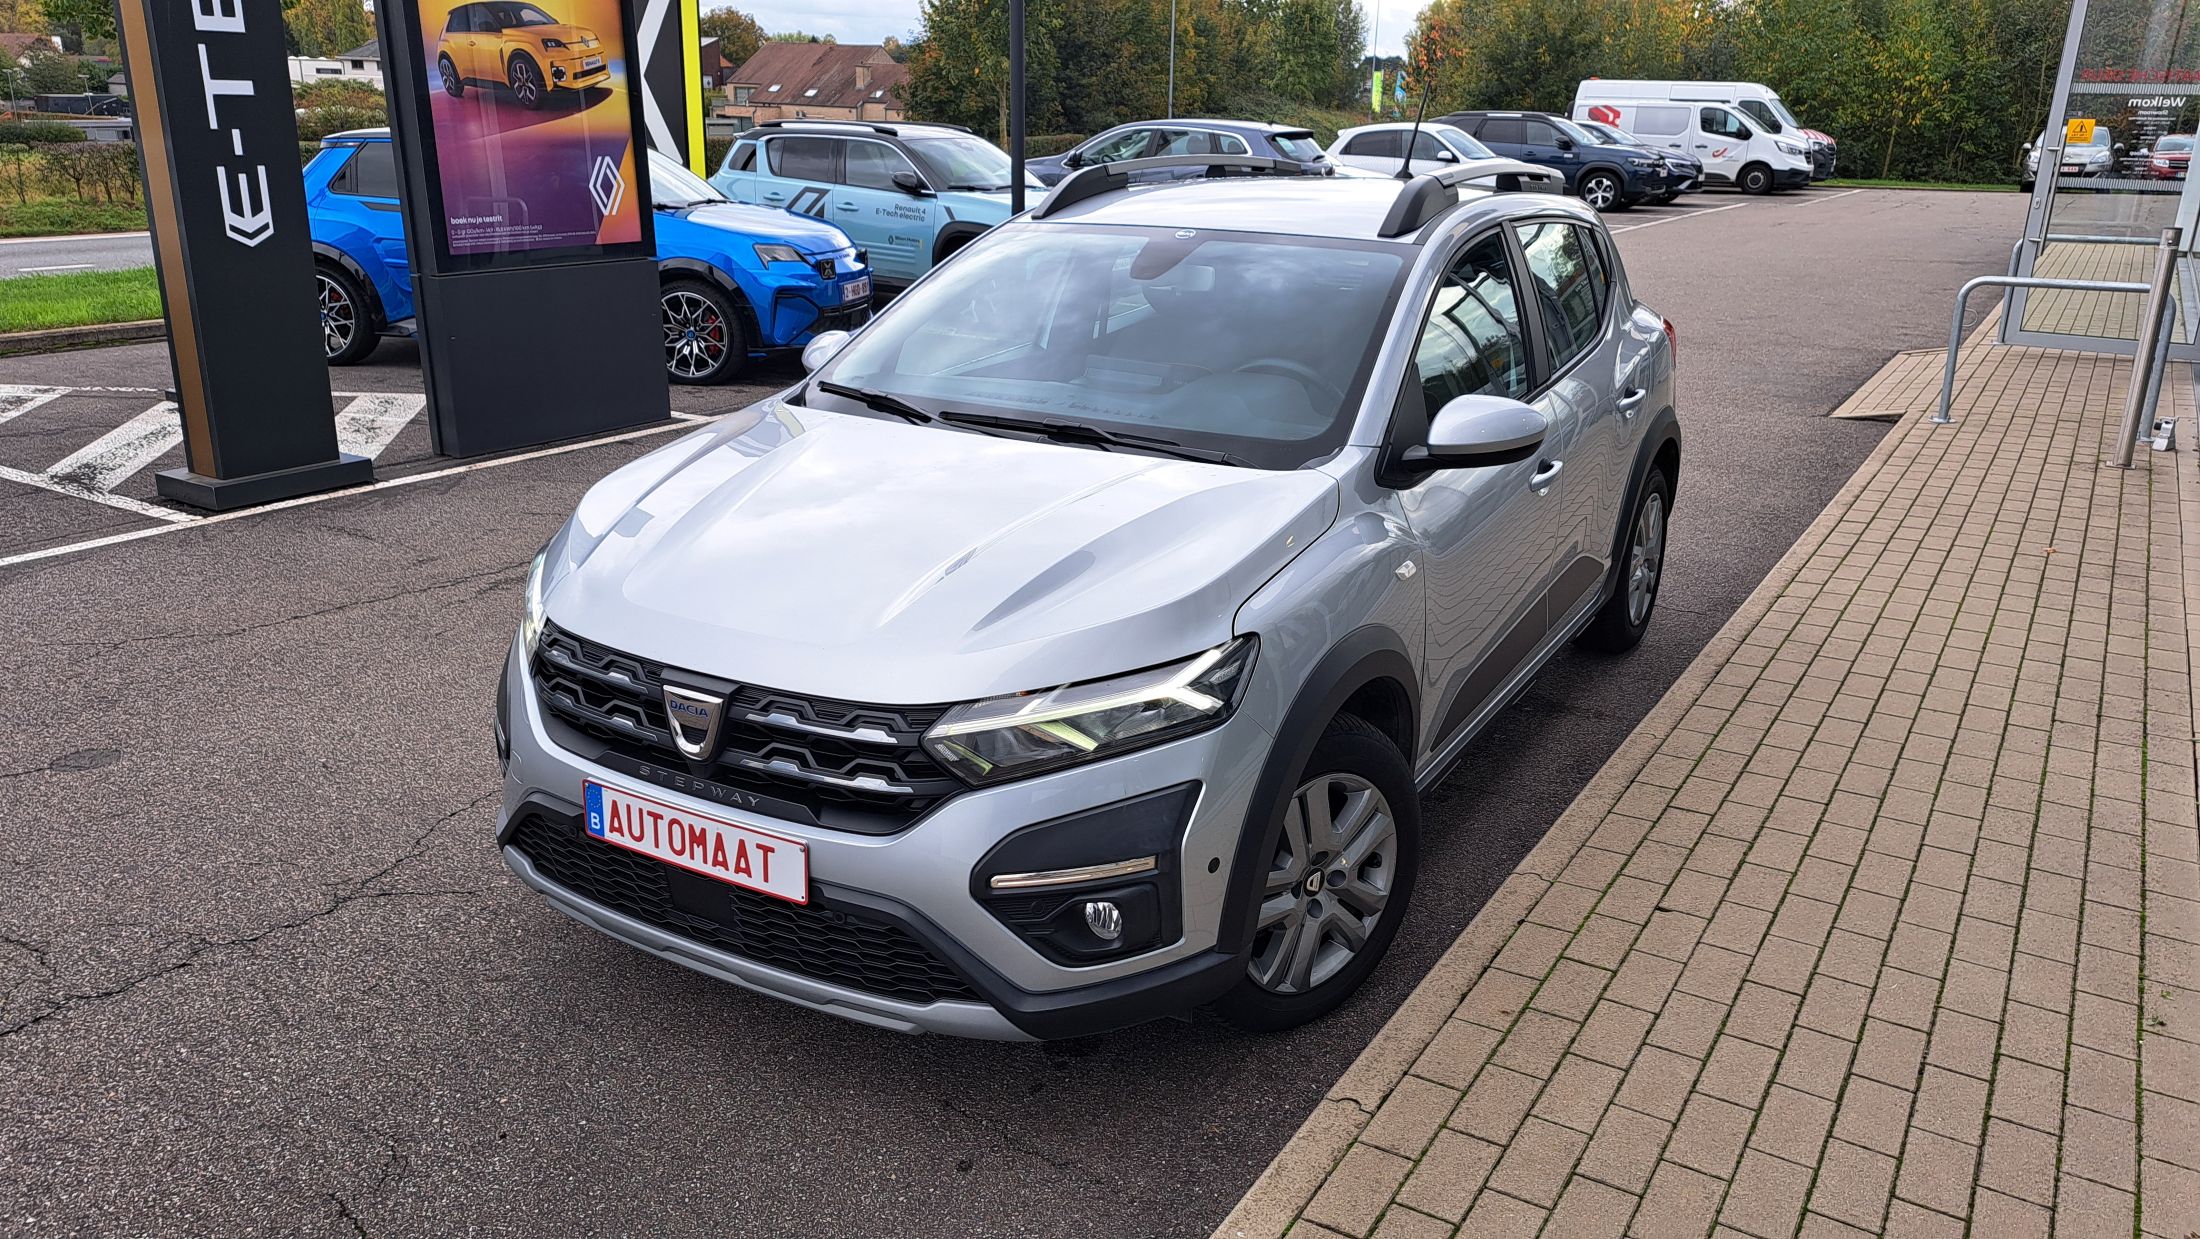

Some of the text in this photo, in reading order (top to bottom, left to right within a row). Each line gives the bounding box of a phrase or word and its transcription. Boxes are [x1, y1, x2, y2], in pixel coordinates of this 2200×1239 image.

[875, 208, 925, 222] E-Tech electric
[895, 203, 921, 214] Renault
[670, 699, 709, 718] DACIA
[638, 765, 760, 808] STEPWAY
[590, 799, 776, 884] B AUTOMAAT
